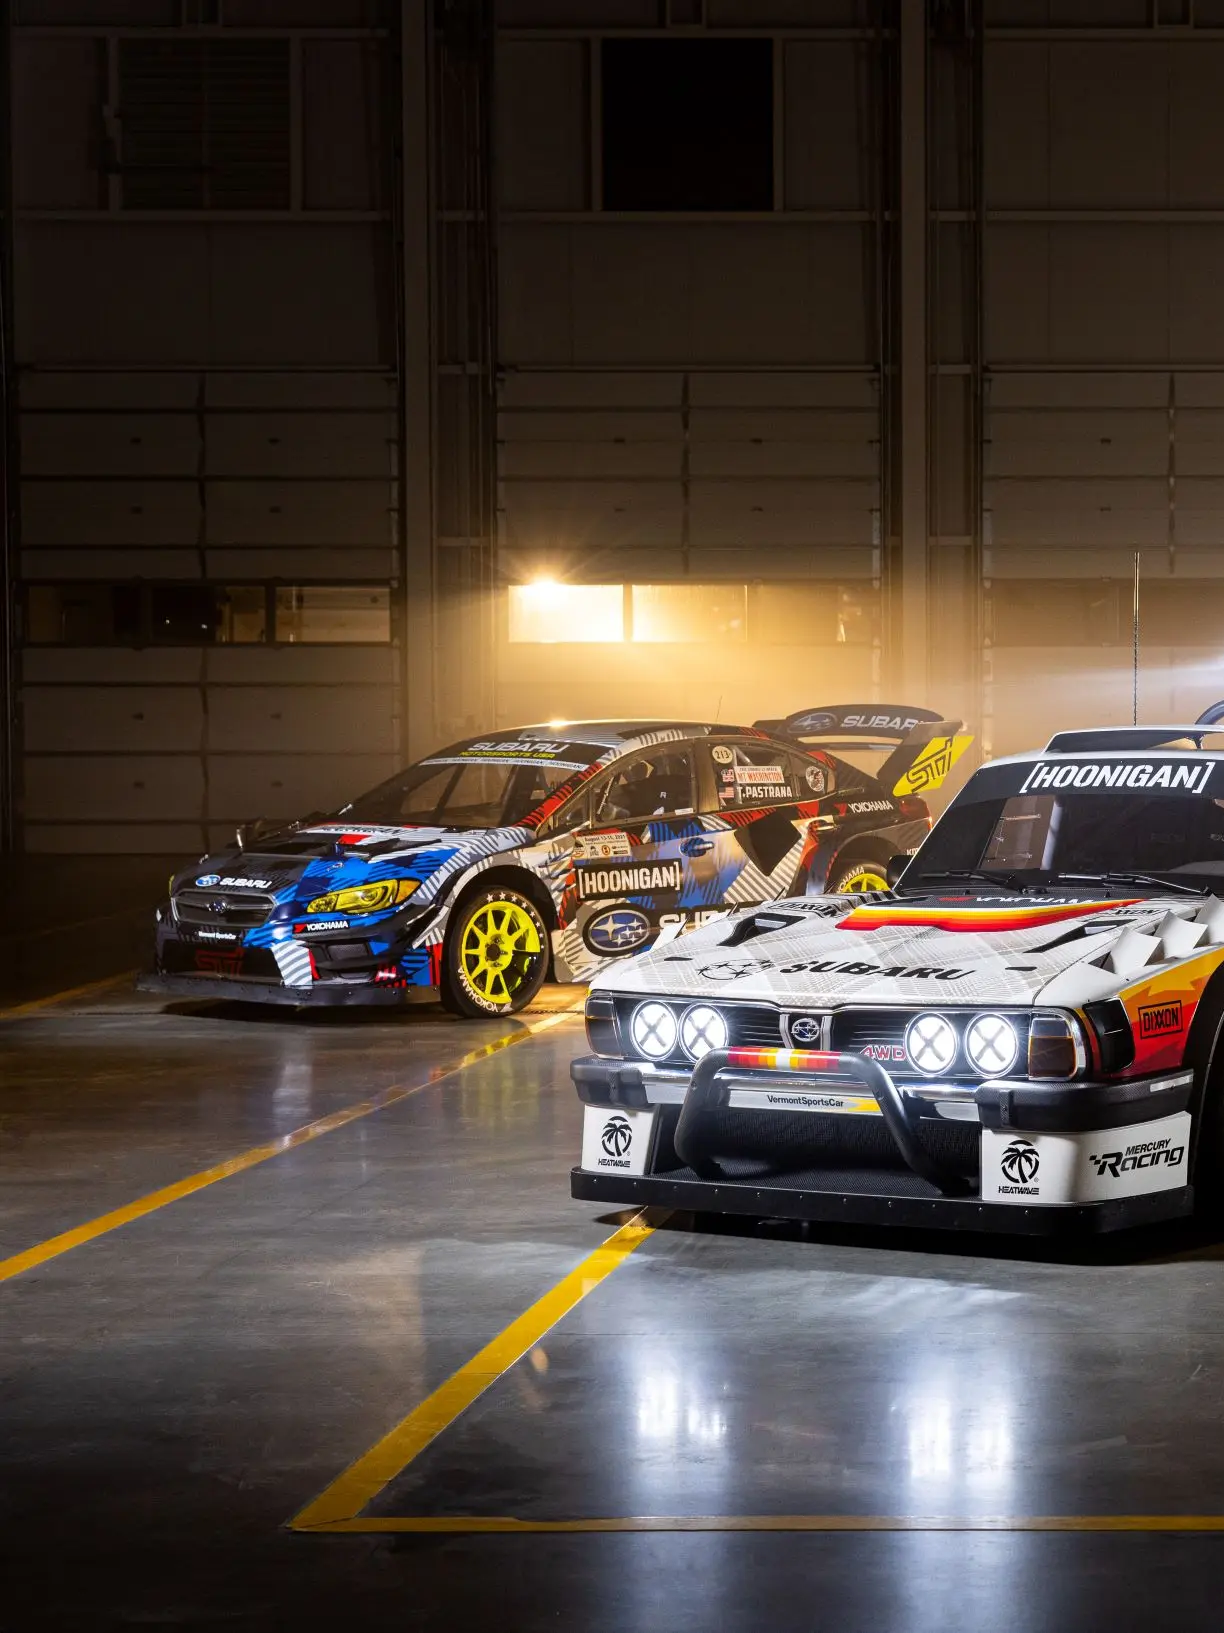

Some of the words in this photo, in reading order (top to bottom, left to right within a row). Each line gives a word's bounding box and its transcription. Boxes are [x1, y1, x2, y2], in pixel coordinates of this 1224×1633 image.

[840, 715, 919, 730] SUBAR
[467, 742, 570, 753] SUBARU
[1019, 761, 1216, 793] [HOONIGAN]
[848, 800, 893, 813] YOKOHAMA
[219, 877, 272, 889] SUBARU
[578, 861, 680, 898] [HOONIGAN]
[306, 920, 348, 931] YOKOHAMA
[780, 961, 977, 980] SUBARU
[457, 965, 498, 1012] YOKOHAMA
[1143, 1007, 1179, 1032] DIXXON
[859, 1044, 906, 1061] 4WD
[767, 1094, 844, 1107] VermontSportsCar
[1125, 1138, 1171, 1156] MERCURY
[1095, 1146, 1185, 1178] Racing
[998, 1185, 1040, 1196] HEATWAVE
